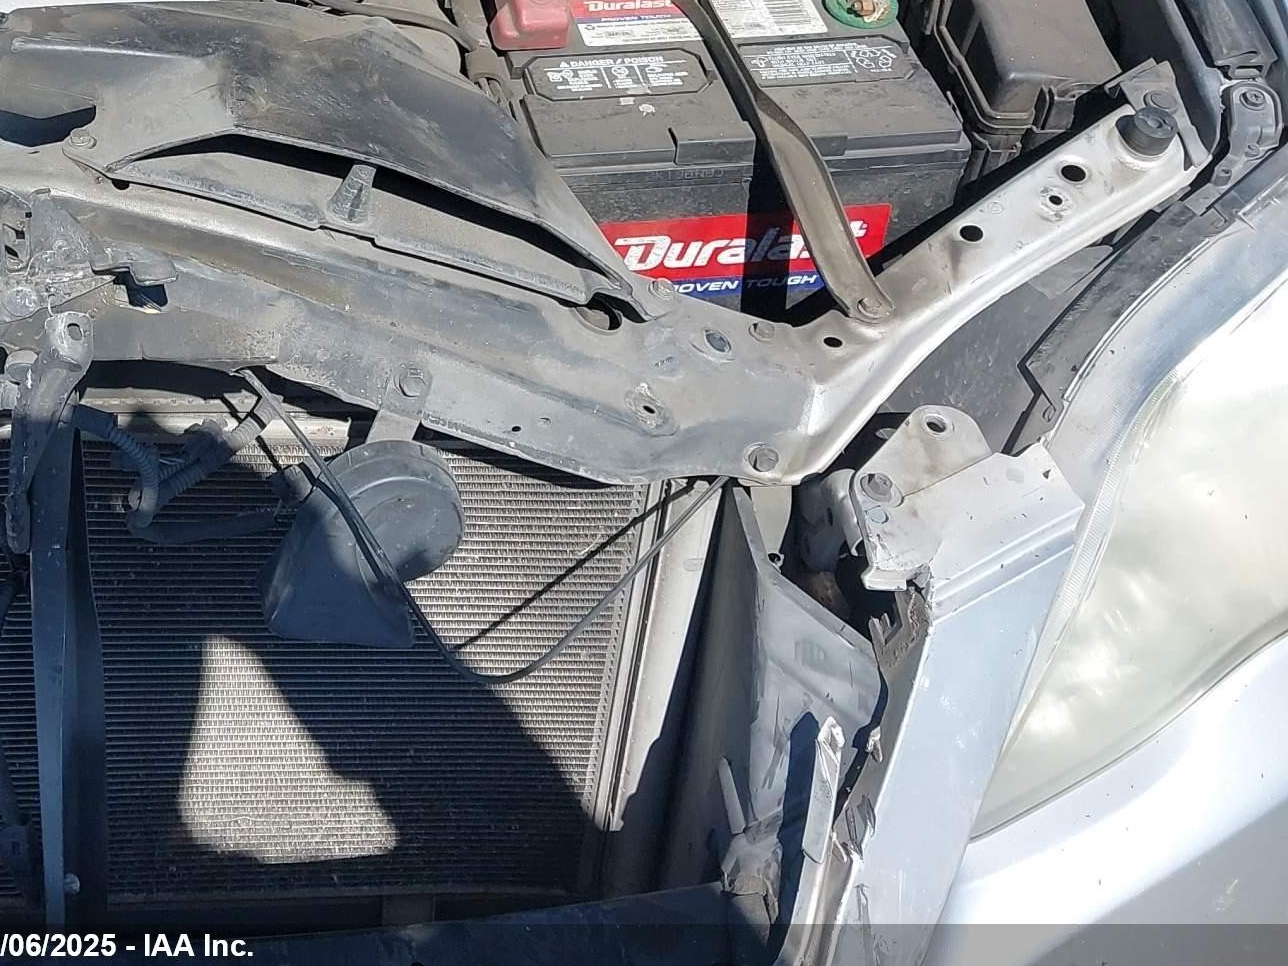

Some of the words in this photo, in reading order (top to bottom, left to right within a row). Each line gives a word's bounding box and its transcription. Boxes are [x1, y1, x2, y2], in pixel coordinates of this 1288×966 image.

[569, 58, 615, 68] DANGER
[624, 56, 664, 65] POISON
[614, 220, 869, 272] Duralat
[673, 280, 739, 293] OVEN
